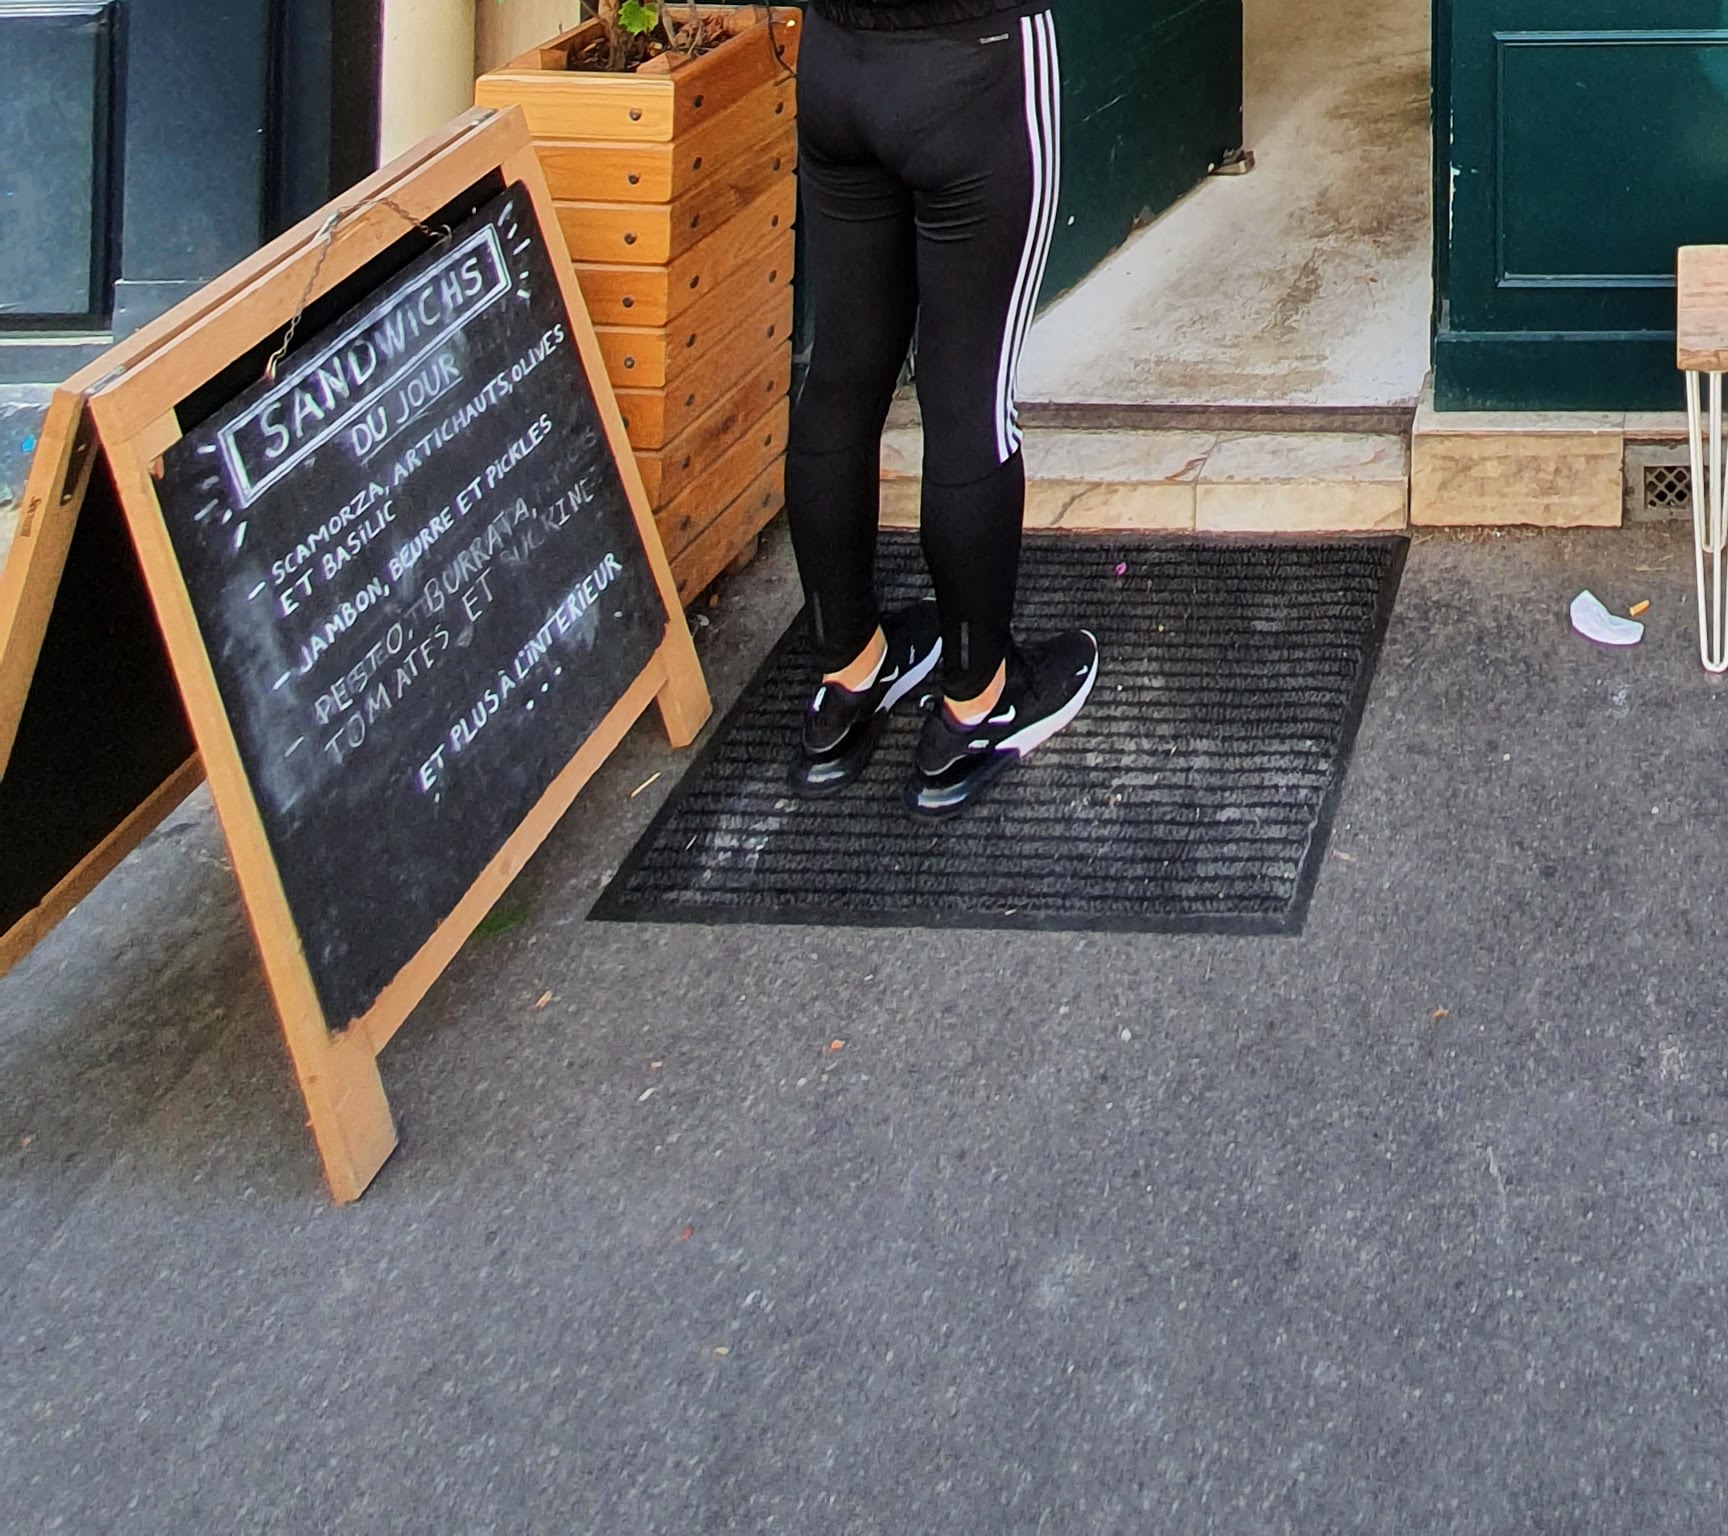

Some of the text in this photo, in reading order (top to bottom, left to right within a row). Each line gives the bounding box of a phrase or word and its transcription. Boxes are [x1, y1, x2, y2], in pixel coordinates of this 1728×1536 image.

[260, 257, 483, 459] SANDWICHS
[351, 353, 461, 458] DU JOUR
[272, 480, 390, 586] SCAMORZA,
[300, 577, 390, 673] JAMBON,
[389, 506, 455, 581] BEURRE
[456, 475, 483, 516] ET
[280, 568, 314, 617] ET
[461, 567, 493, 623] ET
[419, 743, 446, 794] ET
[450, 689, 500, 752] PLUS
